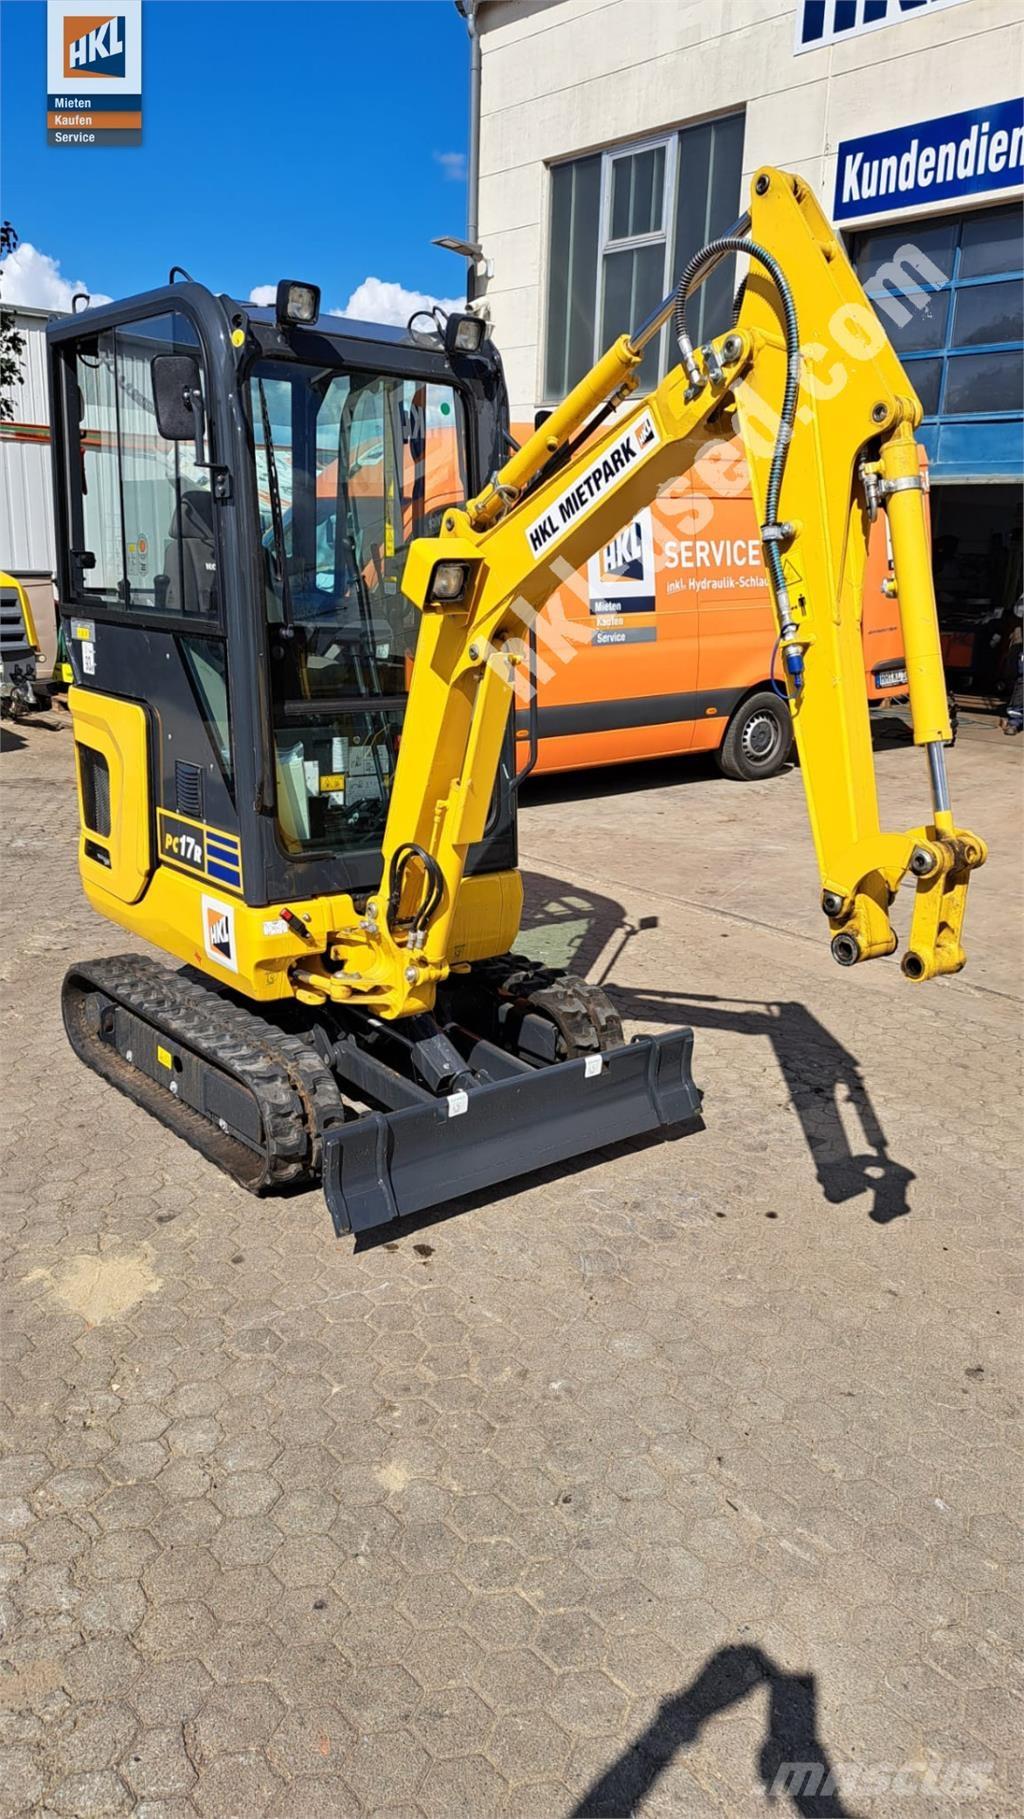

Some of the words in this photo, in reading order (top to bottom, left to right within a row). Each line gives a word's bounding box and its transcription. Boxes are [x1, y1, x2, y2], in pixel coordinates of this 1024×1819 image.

[529, 515, 560, 551] HKL
[558, 437, 637, 523] MIETPARK
[603, 522, 641, 573] HKL
[664, 540, 761, 569] SERVICE
[594, 601, 622, 612] Mieten
[597, 632, 626, 643] Service
[165, 832, 202, 864] PC17R
[210, 915, 229, 945] HKL
